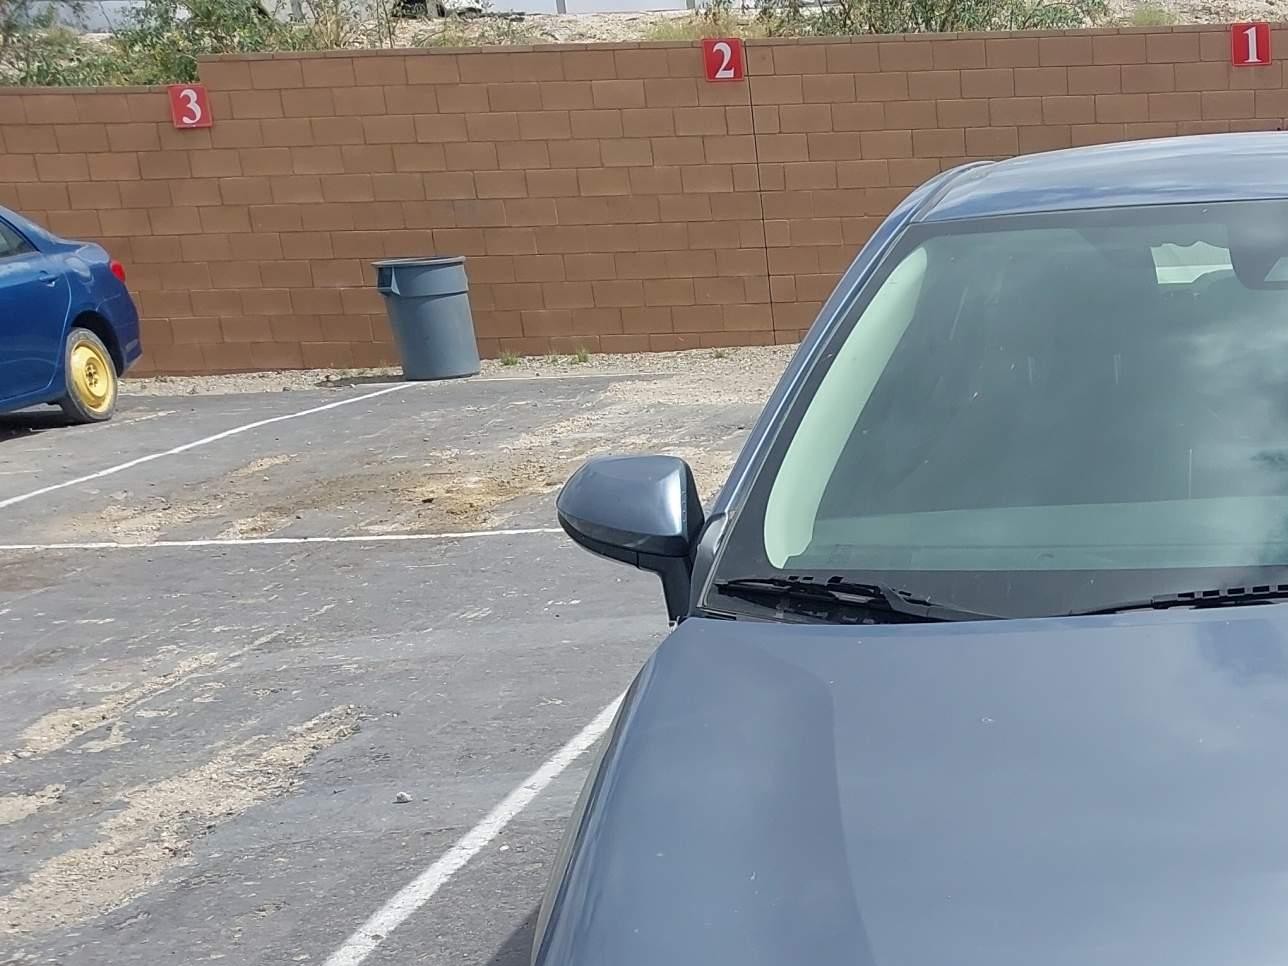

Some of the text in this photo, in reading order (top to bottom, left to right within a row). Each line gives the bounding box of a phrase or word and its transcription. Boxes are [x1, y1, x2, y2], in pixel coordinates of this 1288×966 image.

[713, 42, 735, 79] 2
[1244, 26, 1261, 63] 1
[180, 89, 202, 124] 3
